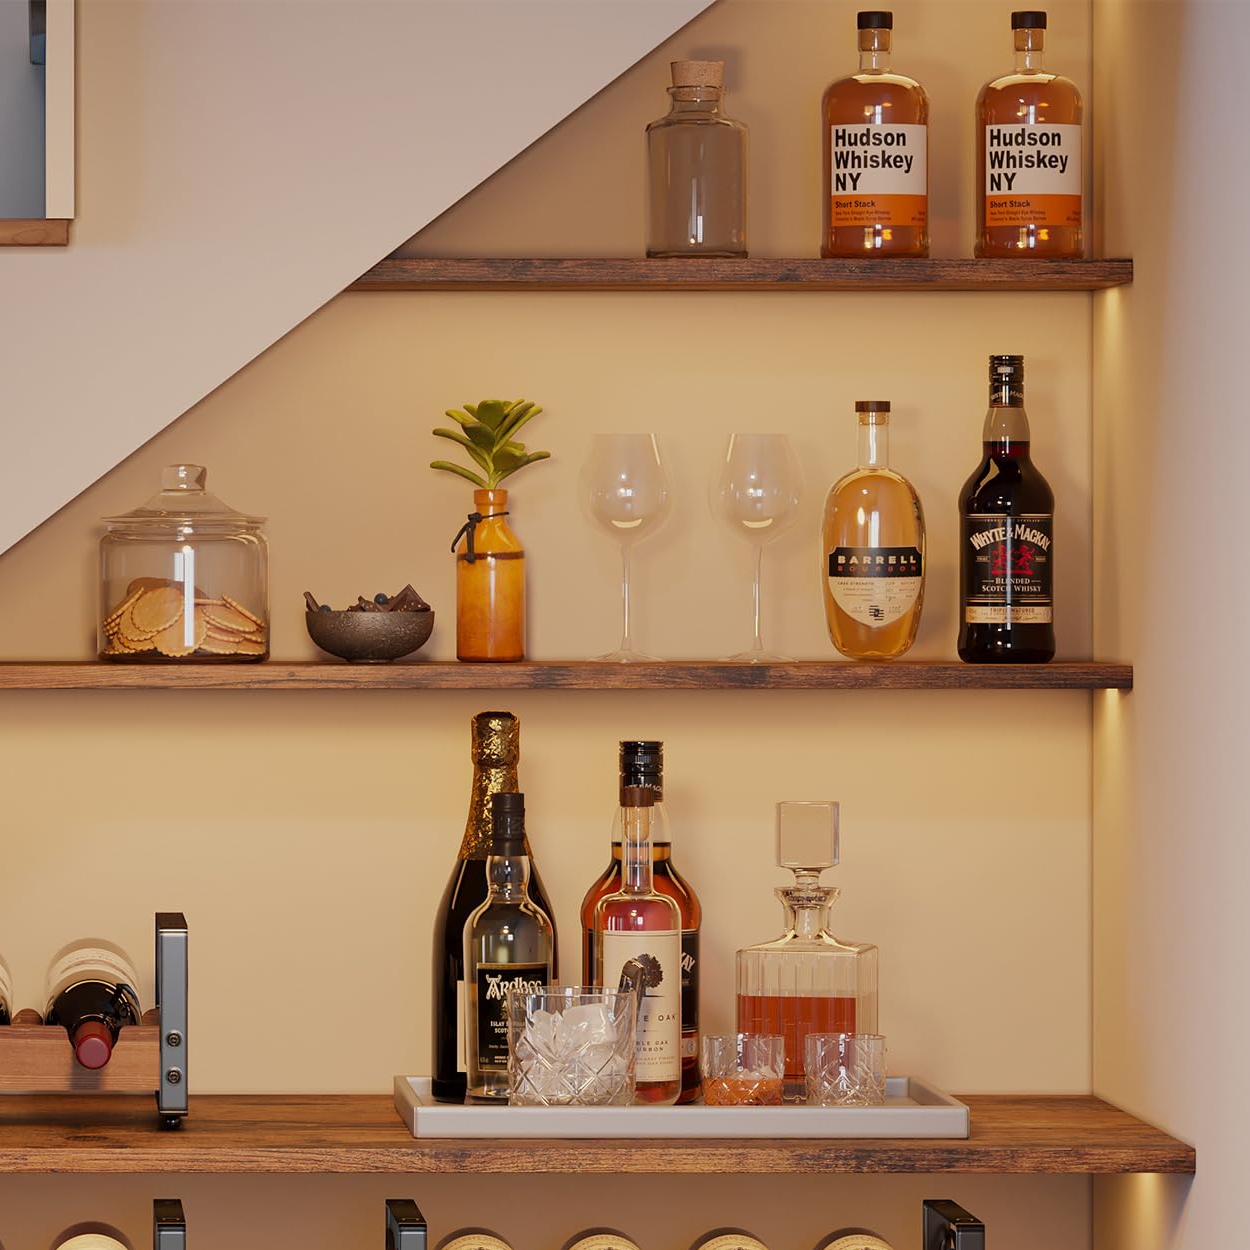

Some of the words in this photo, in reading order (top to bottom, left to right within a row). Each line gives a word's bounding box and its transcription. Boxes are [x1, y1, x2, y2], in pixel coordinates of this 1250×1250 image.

[835, 128, 906, 147] Hudson
[990, 128, 1061, 147] Hudson
[835, 150, 913, 174] Whiskey
[990, 150, 1068, 174] Whiskey
[835, 172, 862, 191] NY
[990, 172, 1016, 191] NY
[835, 200, 852, 208] Short
[854, 200, 876, 208] Stack
[990, 200, 1007, 208] Short
[970, 526, 1006, 550] WHYTE
[1014, 524, 1050, 552] MACKAY
[838, 556, 916, 564] BARRELL
